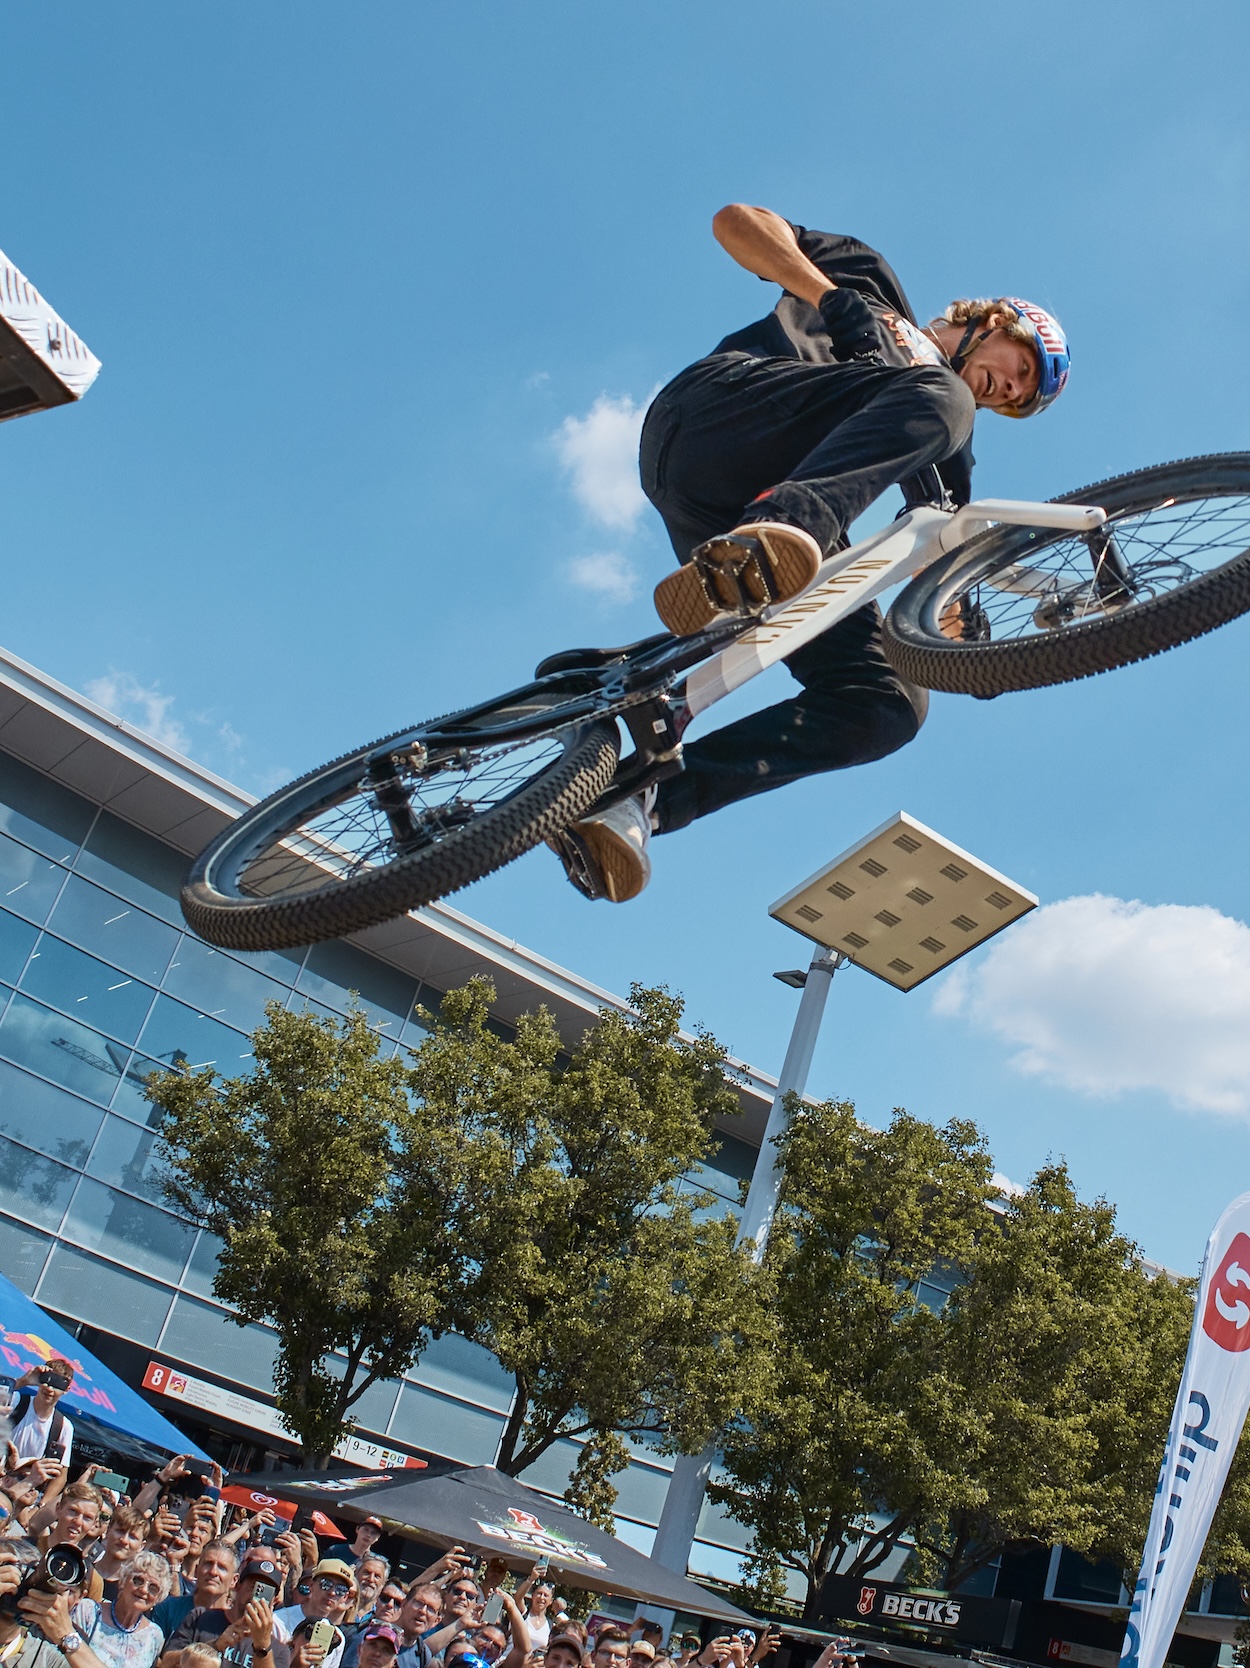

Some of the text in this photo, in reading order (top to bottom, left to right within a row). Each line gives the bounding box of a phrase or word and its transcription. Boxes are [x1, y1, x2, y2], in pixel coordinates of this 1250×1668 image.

[1025, 312, 1064, 352] Bull
[151, 1368, 164, 1386] 8
[882, 1594, 960, 1625] BECK'S
[1052, 1641, 1059, 1655] 8
